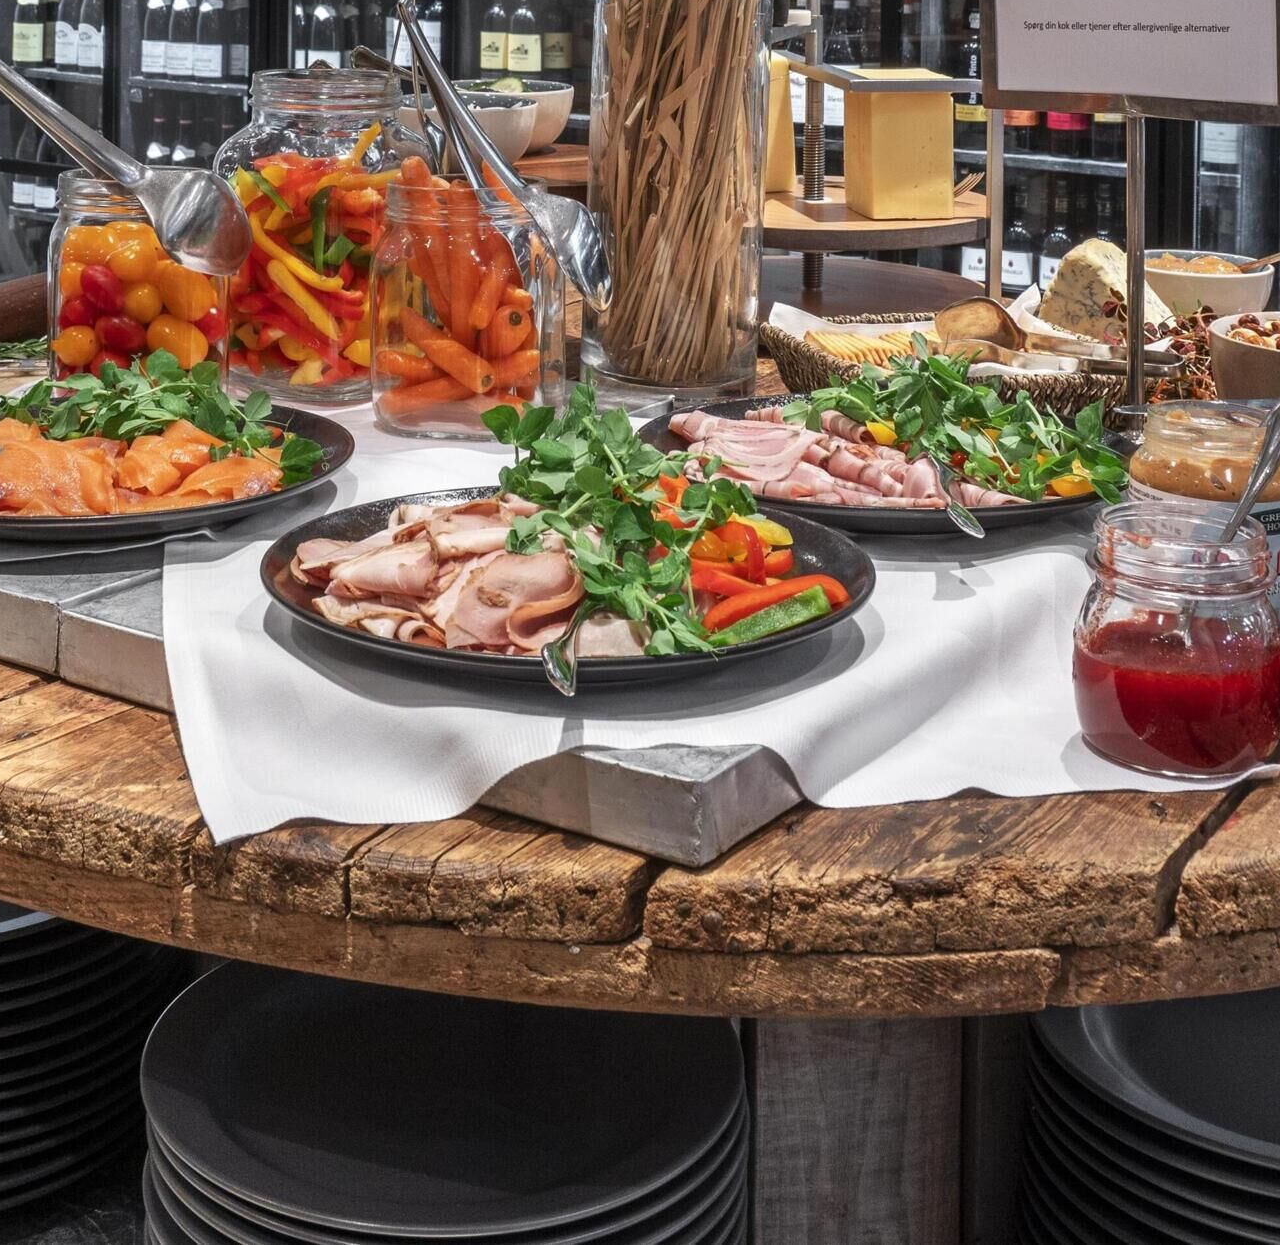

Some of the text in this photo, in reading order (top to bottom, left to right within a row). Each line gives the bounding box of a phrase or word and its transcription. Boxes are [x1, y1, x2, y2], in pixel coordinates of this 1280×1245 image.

[1024, 21, 1230, 33] Spørg din kok eller tjener efter allergivenlige alternativer
[968, 55, 977, 76] Pinto
